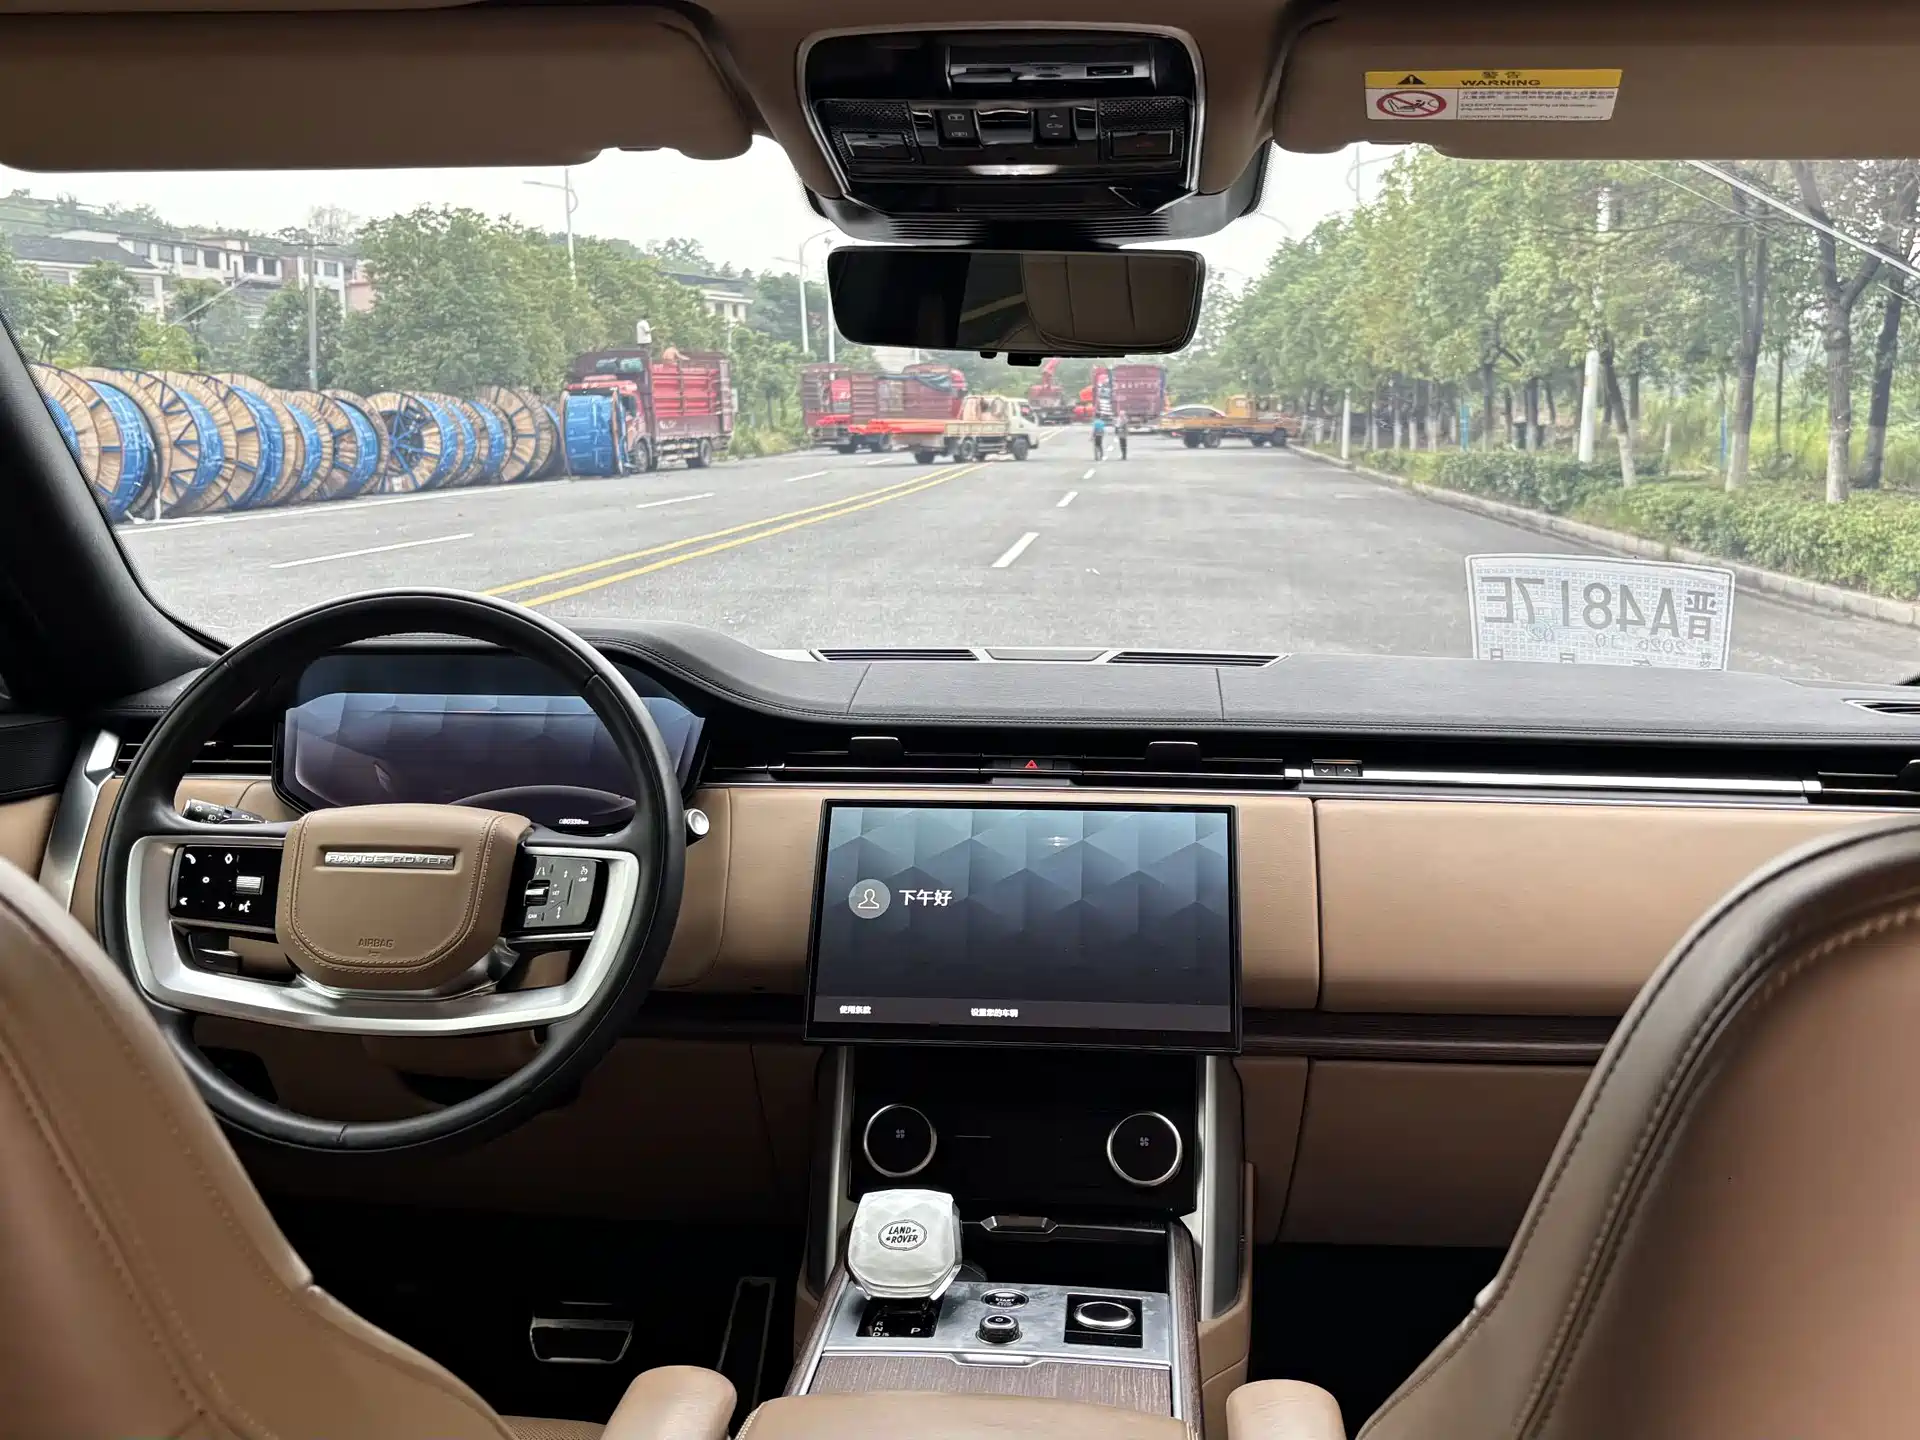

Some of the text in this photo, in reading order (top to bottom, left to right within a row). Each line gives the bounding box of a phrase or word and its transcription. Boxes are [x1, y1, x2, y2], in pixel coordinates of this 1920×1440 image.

[327, 854, 452, 866] RANGE ROVER
[898, 888, 953, 907] 下午好
[358, 937, 394, 948] AIRBAG
[839, 1005, 872, 1015] 使用条款
[888, 1226, 912, 1235] LAND
[890, 1234, 919, 1244] ROVER
